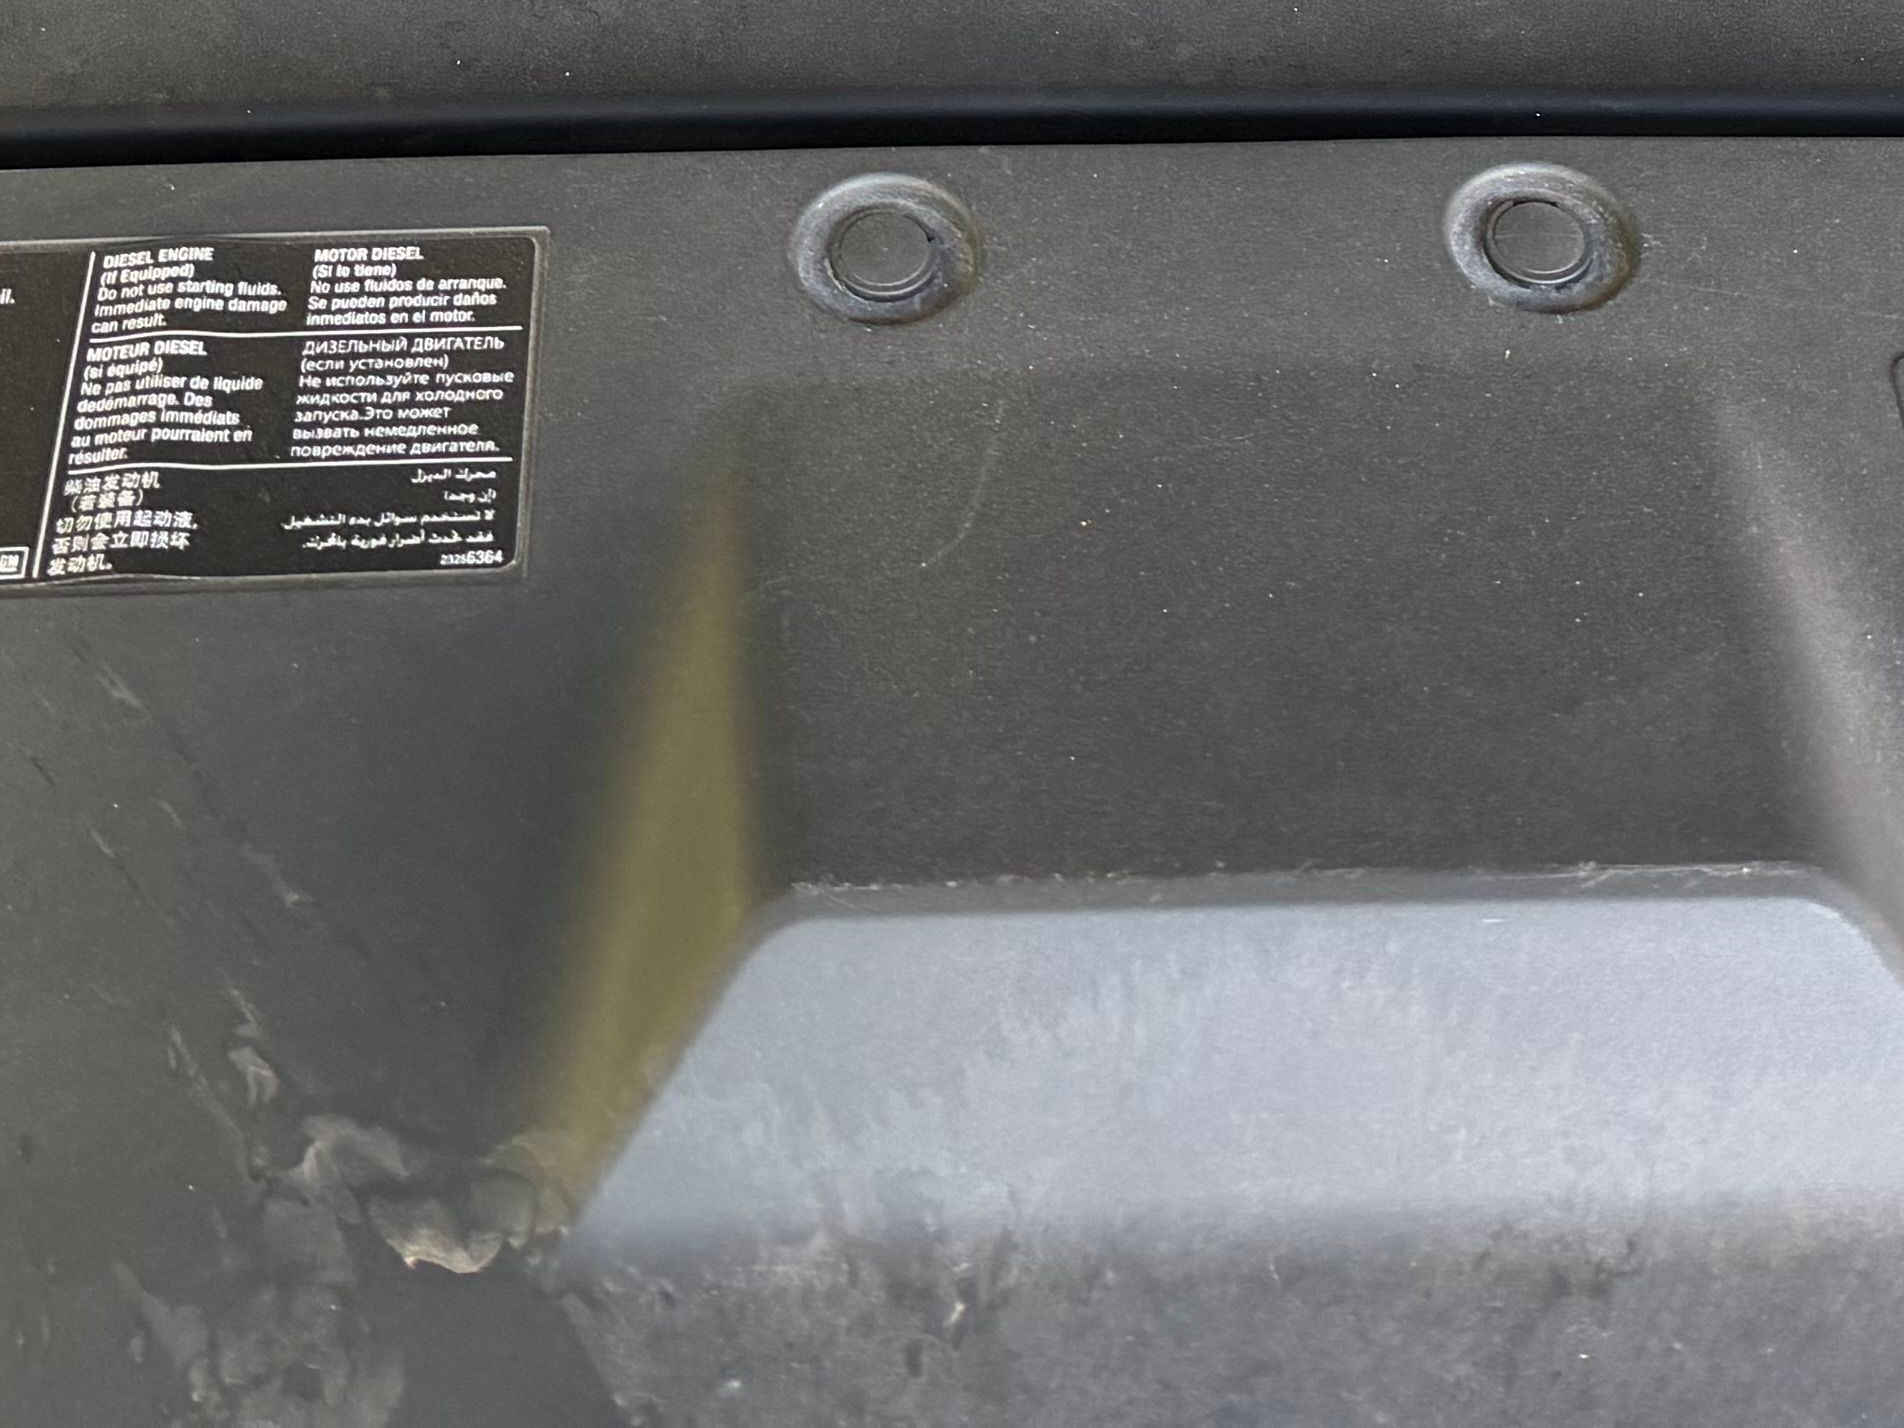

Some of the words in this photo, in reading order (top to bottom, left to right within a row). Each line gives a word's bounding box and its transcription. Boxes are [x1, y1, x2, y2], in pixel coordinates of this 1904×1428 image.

[102, 250, 155, 269] DIESEL
[158, 246, 215, 263] ENGINE
[314, 248, 368, 263] MOTOR
[371, 246, 425, 262] DIESEL
[100, 270, 117, 286] (If
[120, 263, 196, 284] Equipped)
[354, 263, 397, 278] tiene)
[97, 287, 118, 302] Do
[121, 285, 144, 299] not
[147, 283, 174, 296] use
[177, 280, 234, 297] starting
[238, 281, 283, 296] fluids.
[310, 280, 331, 294] No
[334, 282, 360, 293] use
[363, 279, 414, 293] fluidos
[416, 277, 435, 291] de
[438, 278, 508, 293] arranque.
[94, 297, 171, 317] Immediate
[174, 296, 225, 313] engine
[228, 299, 288, 315] damage
[307, 296, 327, 310] Se
[330, 296, 385, 311] pueden
[388, 293, 451, 309] producir
[453, 292, 498, 306] daños
[91, 319, 119, 334] can
[122, 312, 168, 331] result.
[306, 311, 387, 326] inmediatos
[390, 313, 409, 324] en
[412, 310, 427, 323] el
[430, 310, 476, 323] motor.
[86, 341, 150, 362] MOTEUR
[153, 339, 208, 356] DIESEL
[301, 336, 408, 356] ДИЗЕЛЬНЫЙ
[410, 336, 505, 353] ДВИГАТЕЛЬ
[83, 364, 103, 381] (si
[106, 357, 164, 377] équipé)
[300, 357, 345, 373] (если
[348, 353, 450, 372] установлен)
[80, 381, 102, 396] Ne
[104, 380, 132, 396] pas
[135, 374, 188, 391] utiliser
[189, 374, 210, 389] de
[213, 375, 264, 394] liquide
[298, 374, 321, 388] Не
[325, 372, 430, 389] используйте
[435, 370, 515, 387] пусковые
[183, 391, 213, 407] Des
[295, 390, 378, 406] жидкости
[380, 390, 411, 404] для
[414, 388, 504, 404] холодного
[74, 409, 157, 430] dommages
[396, 406, 452, 420] может
[70, 434, 91, 448] au
[94, 427, 147, 445] moteur
[150, 426, 230, 443] pourraient
[233, 428, 253, 442] en
[291, 426, 360, 441] вызвать
[363, 423, 480, 439] немедленное
[67, 446, 129, 465] résulter.
[289, 441, 407, 459] повреждение
[409, 440, 501, 456] двигателя.
